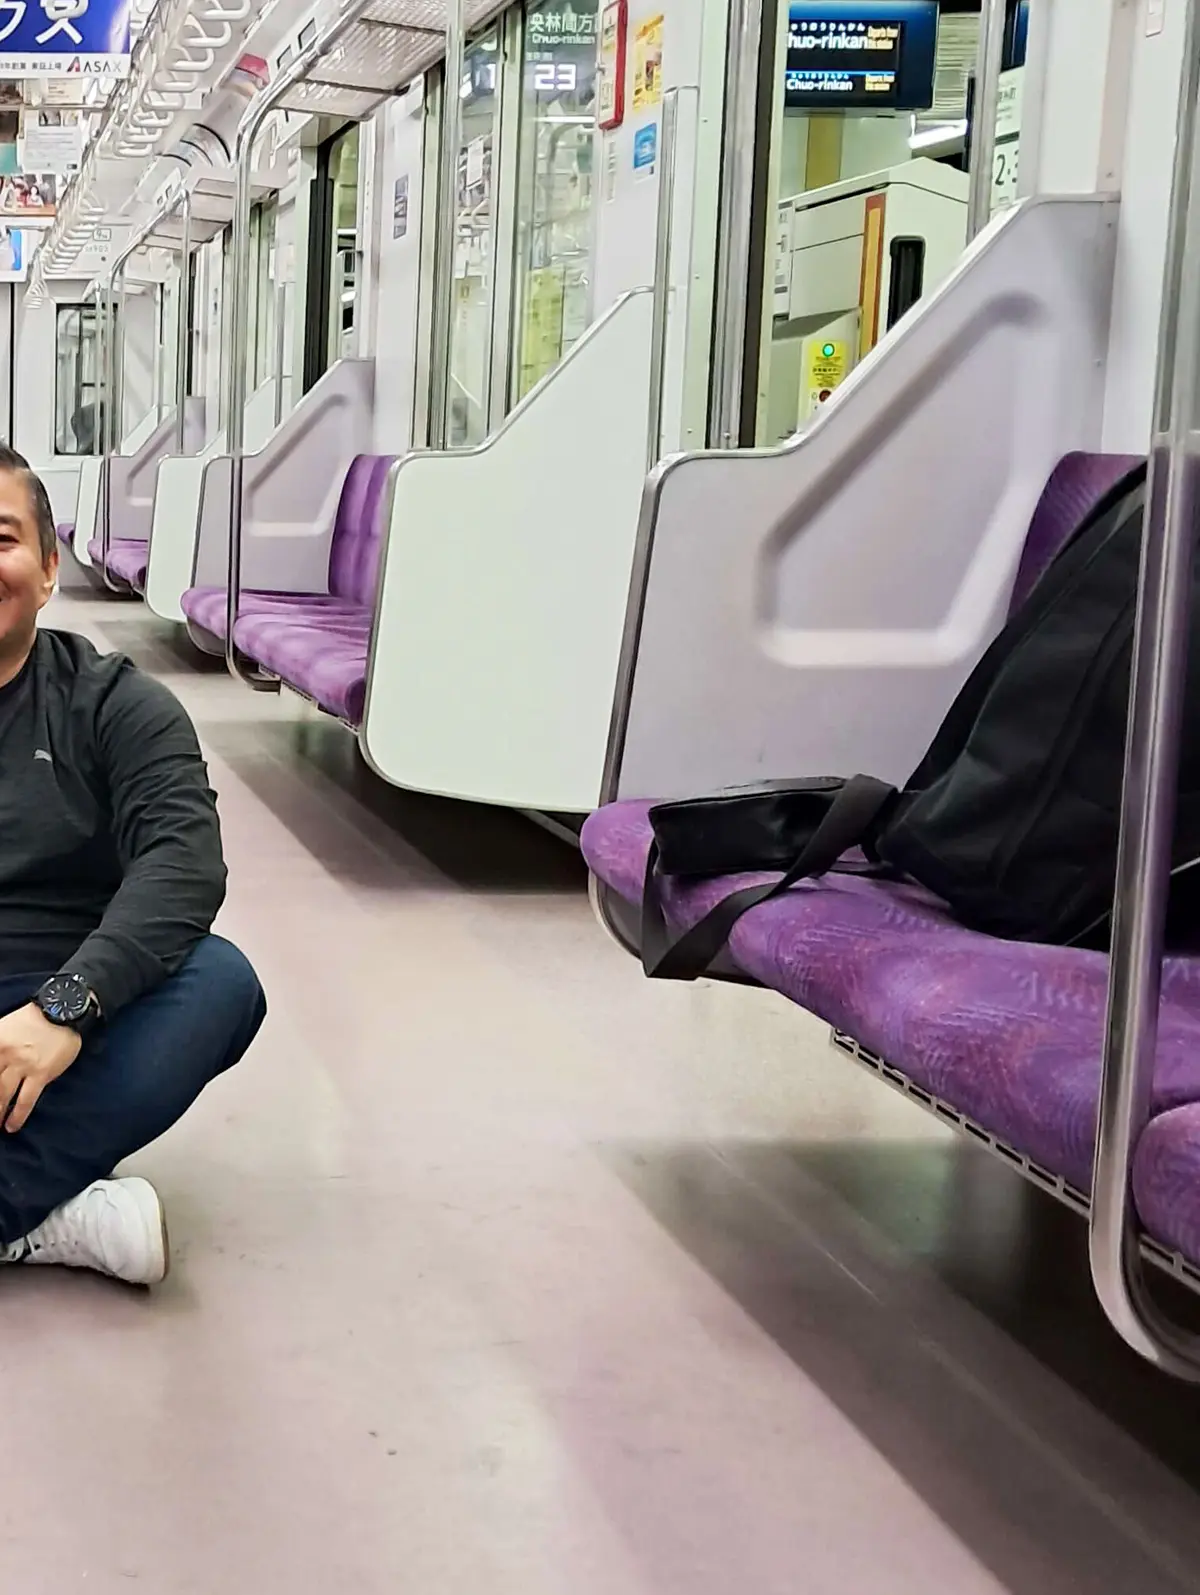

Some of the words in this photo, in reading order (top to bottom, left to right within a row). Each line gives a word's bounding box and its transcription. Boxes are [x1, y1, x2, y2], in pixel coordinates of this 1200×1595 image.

[530, 12, 598, 33] 央林間方
[532, 34, 595, 44] Chuo-rinkan
[788, 31, 867, 49] huo-rinkan
[535, 64, 576, 90] 23
[786, 78, 853, 91] Chuo-rinkan
